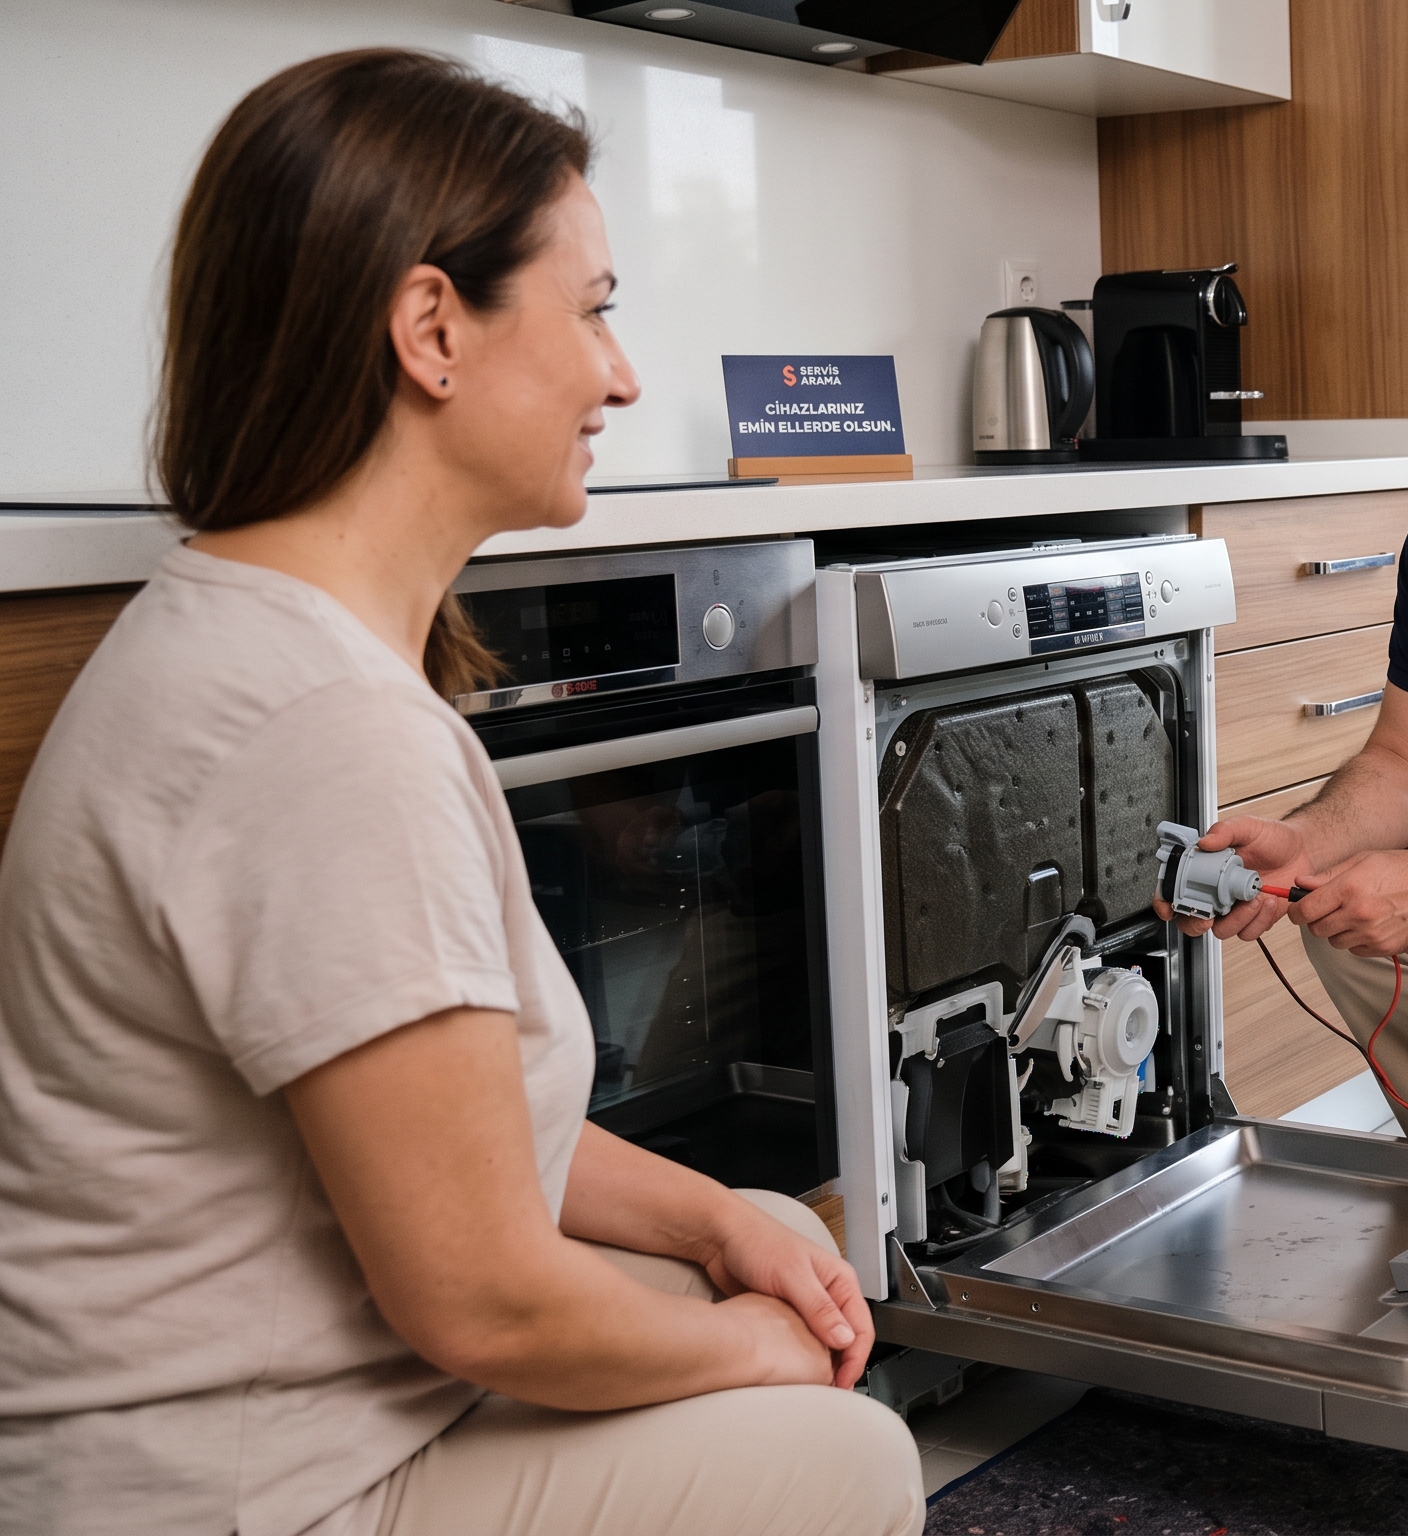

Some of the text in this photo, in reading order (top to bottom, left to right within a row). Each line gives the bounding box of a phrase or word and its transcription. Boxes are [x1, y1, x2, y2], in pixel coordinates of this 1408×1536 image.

[800, 363, 839, 375] SERVİS
[800, 376, 842, 386] ARAMA
[765, 401, 865, 415] CİHAZLARINIZ
[738, 419, 896, 433] EMİN ELLERDE OLSUN.
